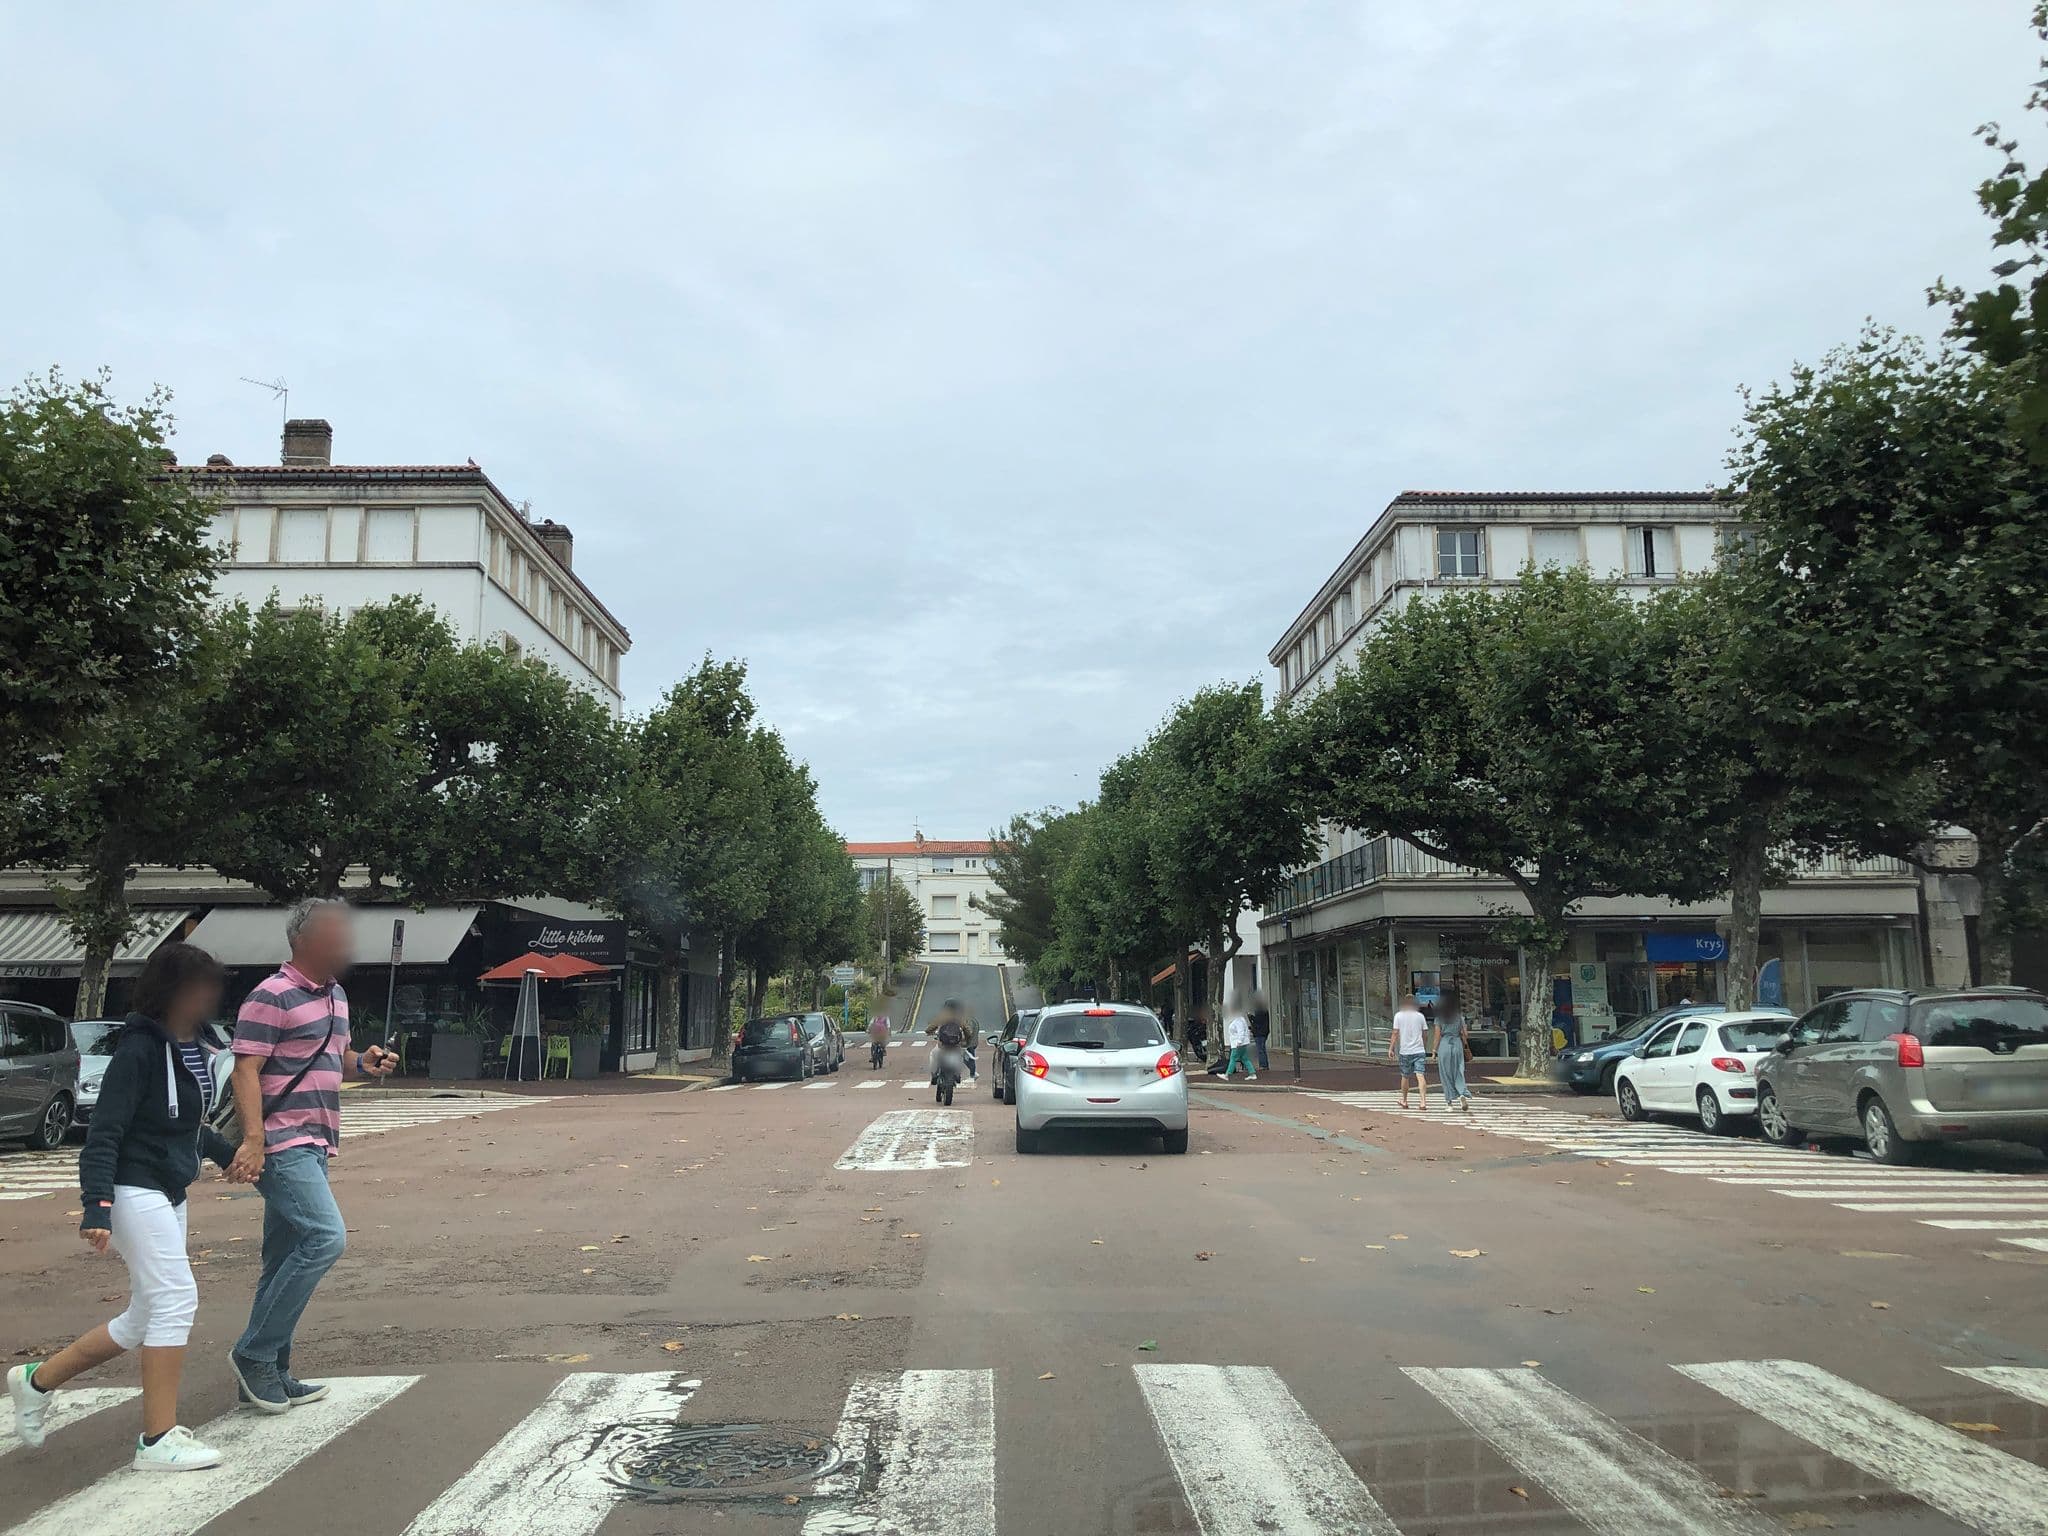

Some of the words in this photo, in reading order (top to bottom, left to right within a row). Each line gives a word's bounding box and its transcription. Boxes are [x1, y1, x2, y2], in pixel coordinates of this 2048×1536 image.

[528, 927, 565, 948] Little
[567, 929, 605, 946] kitchen
[1696, 939, 1721, 951] Krys
